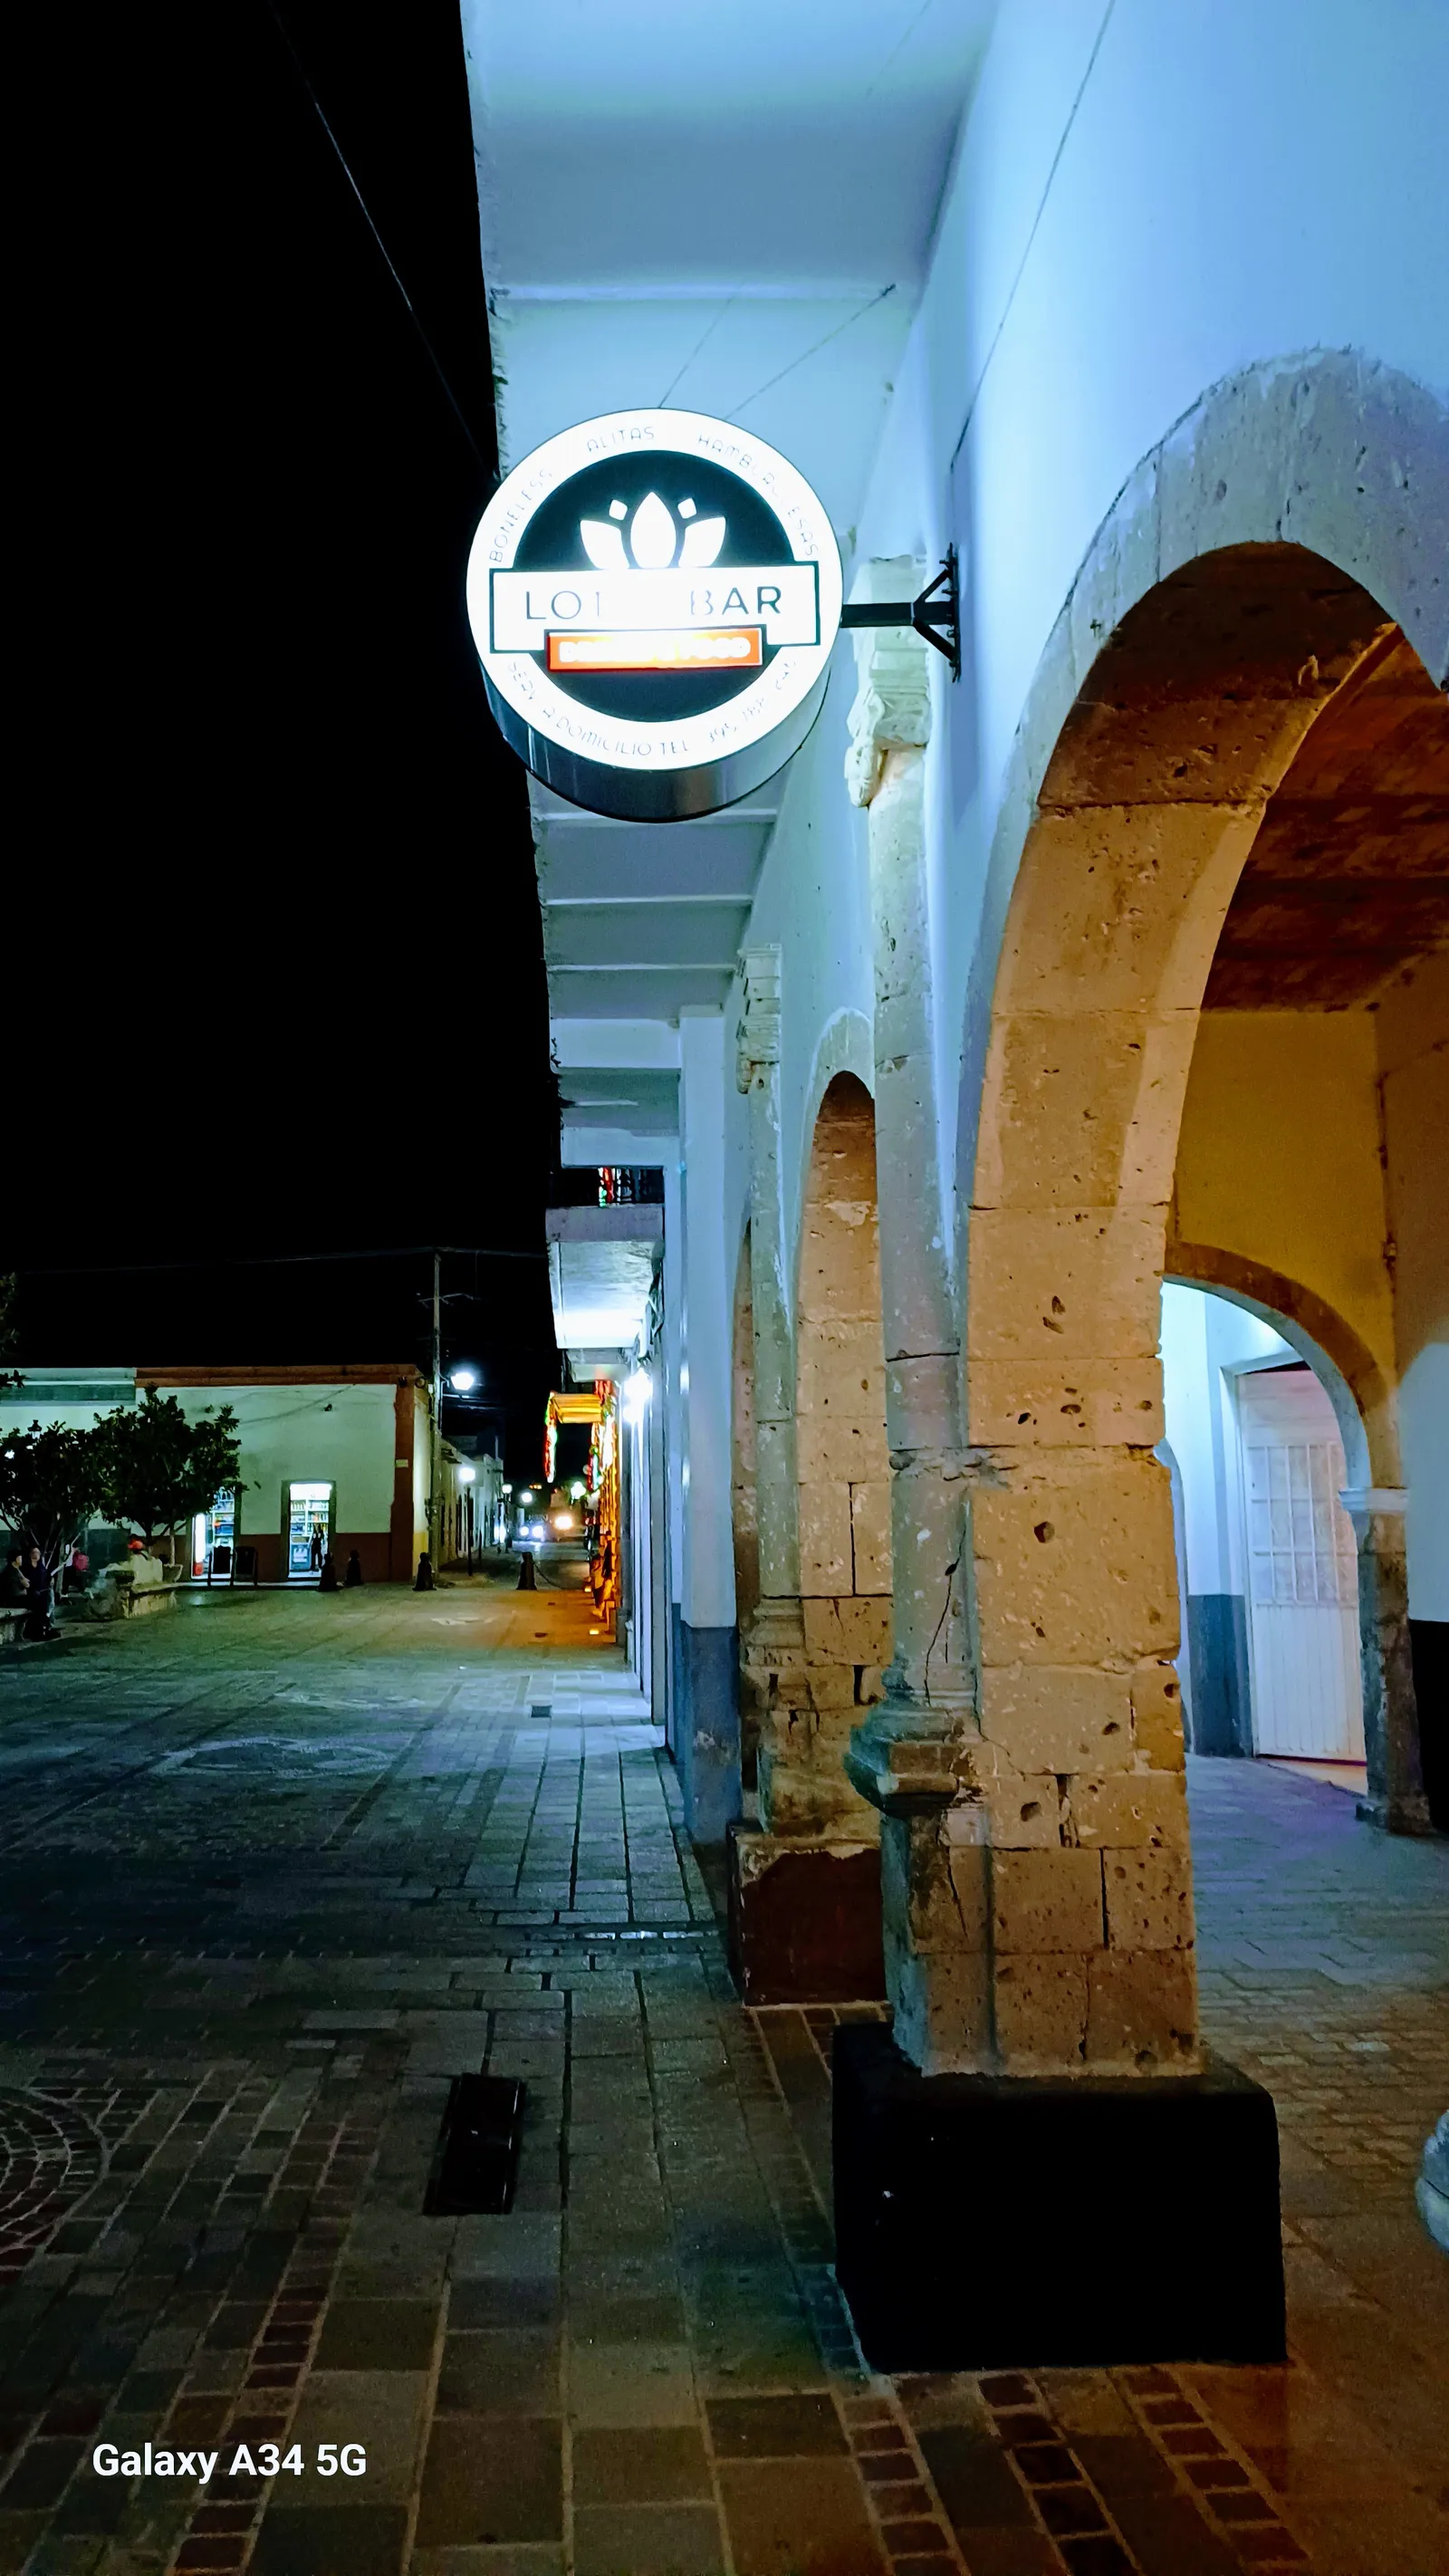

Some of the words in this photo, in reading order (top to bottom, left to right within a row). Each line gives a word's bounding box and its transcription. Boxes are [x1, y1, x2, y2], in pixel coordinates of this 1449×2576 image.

[488, 467, 554, 563] BONELESS
[586, 426, 656, 453] ALITAS
[689, 584, 783, 617] BAR
[554, 716, 652, 757] DOMICILIO
